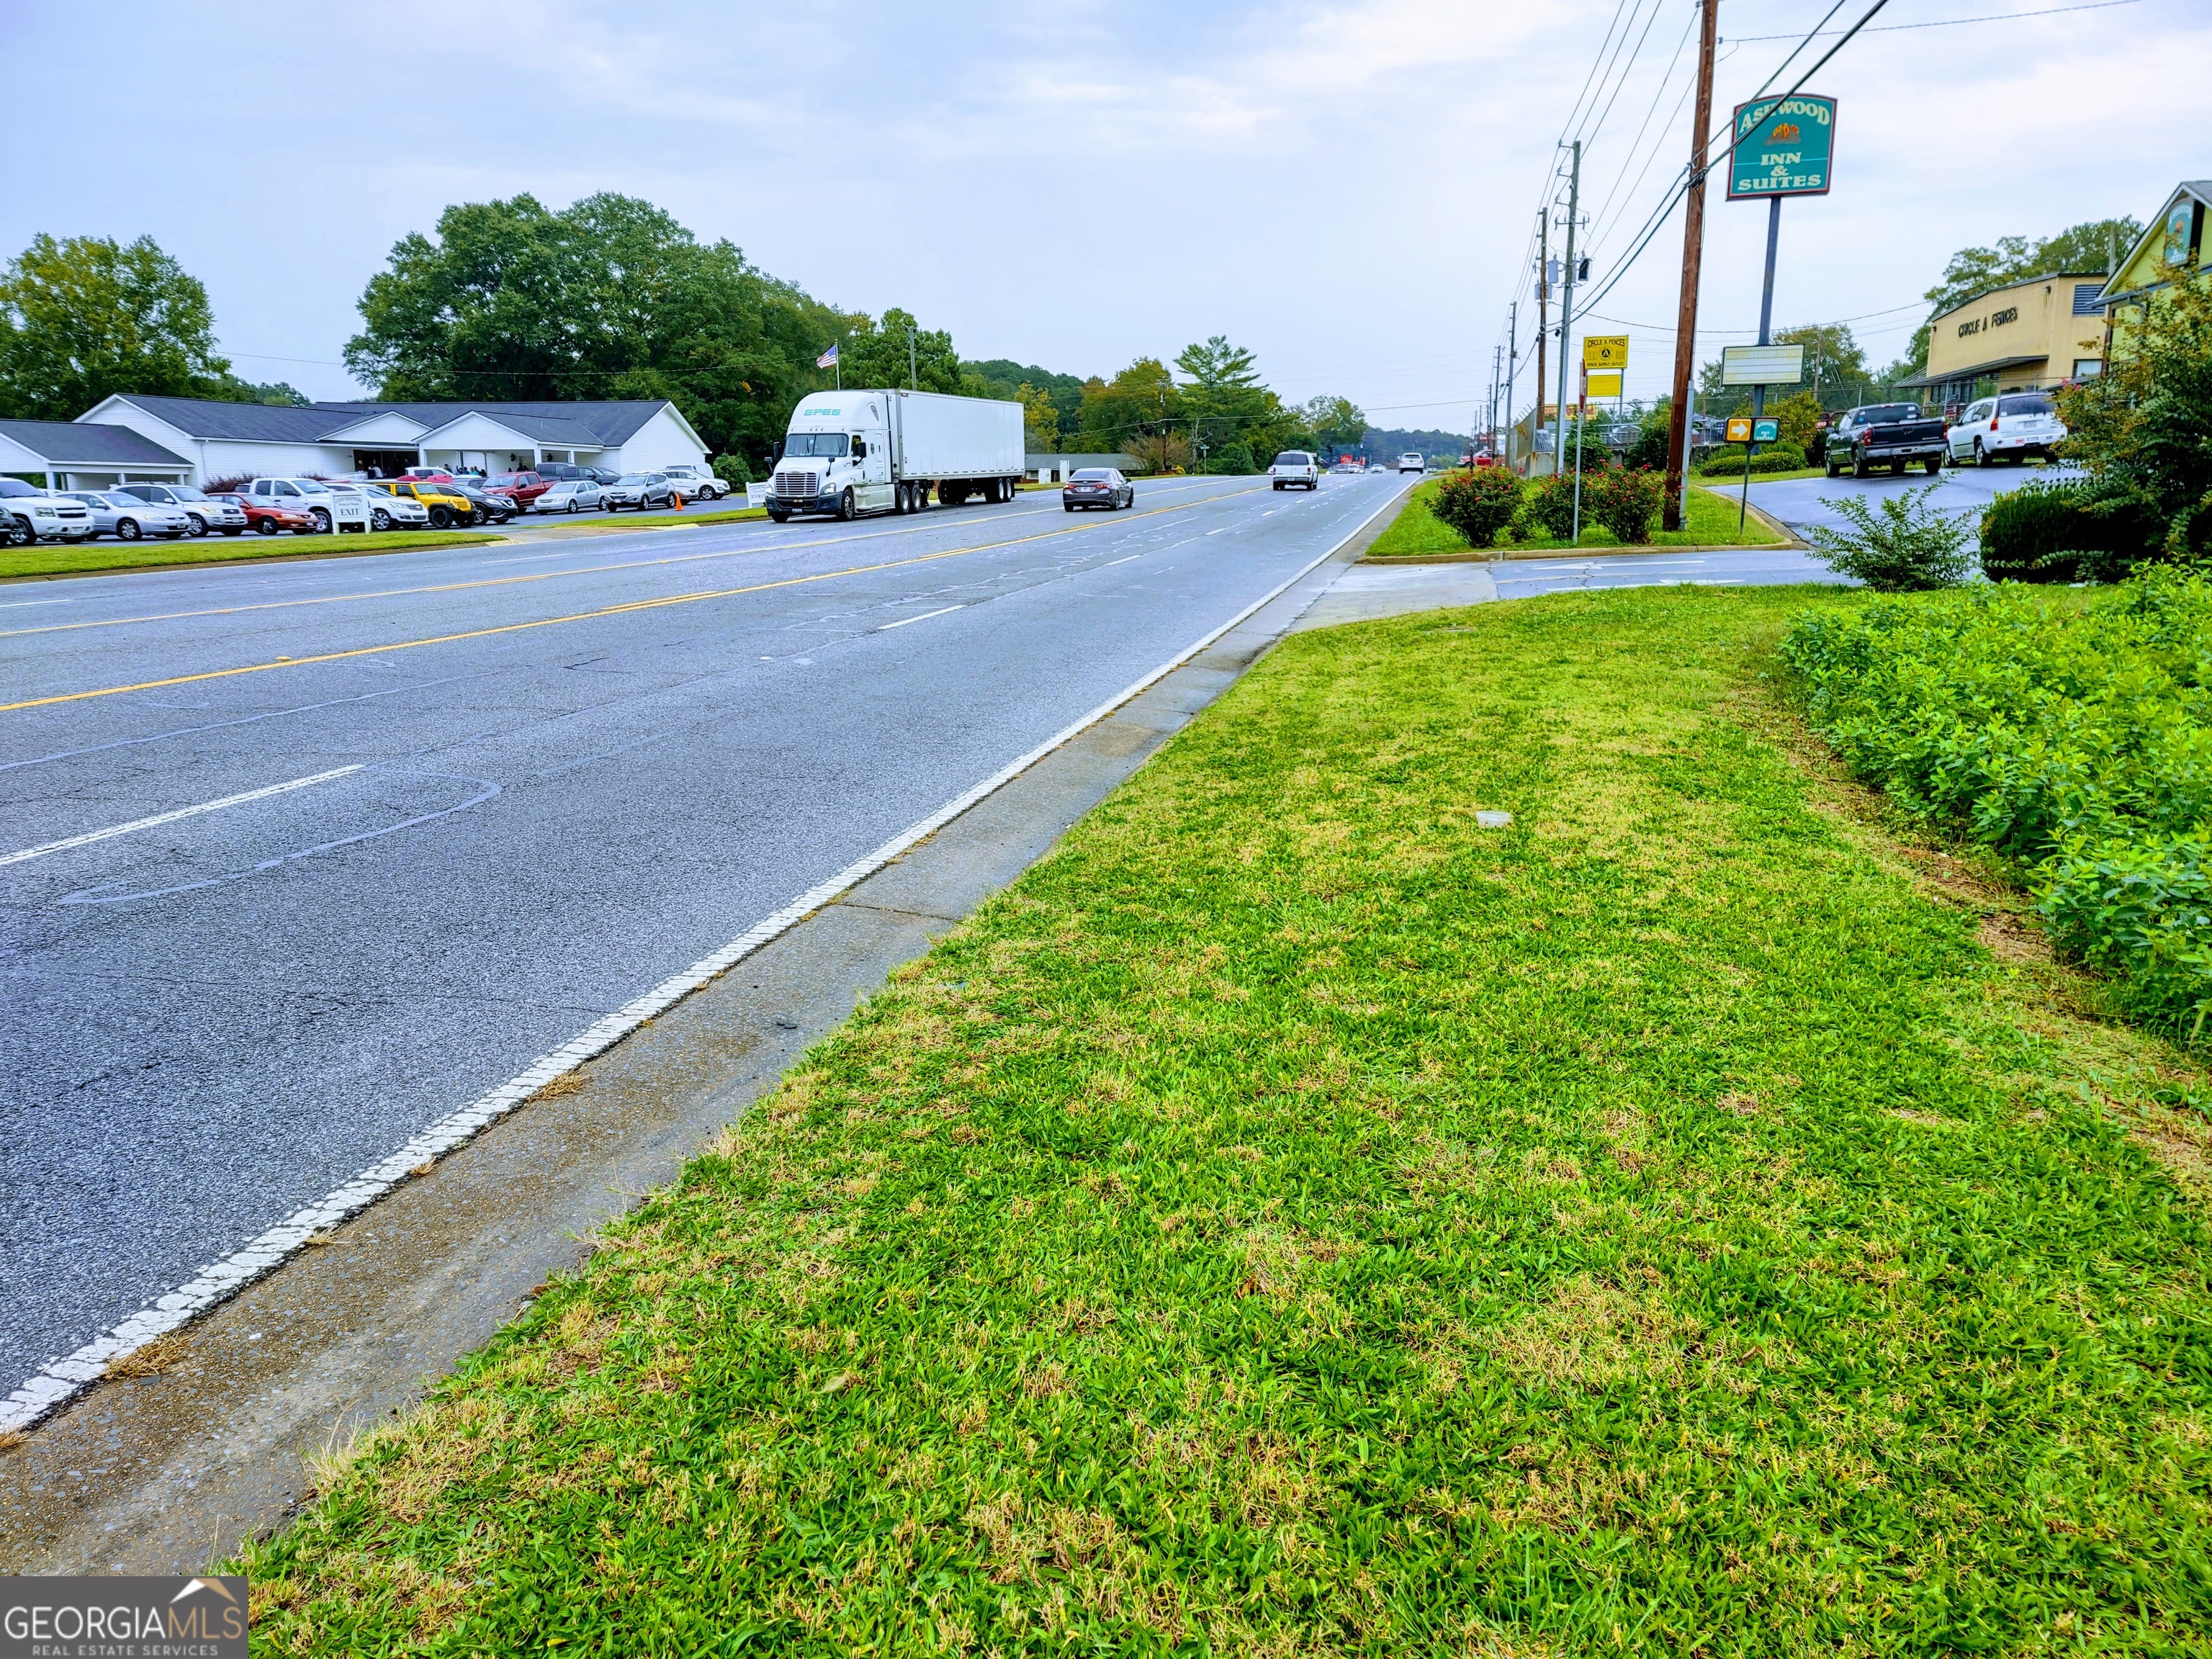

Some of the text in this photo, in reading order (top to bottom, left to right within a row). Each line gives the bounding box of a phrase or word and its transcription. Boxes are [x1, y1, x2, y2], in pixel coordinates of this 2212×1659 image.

[1739, 100, 1830, 134] ASHWOOD
[1761, 152, 1802, 166] INN
[1770, 165, 1789, 176] &
[1737, 174, 1822, 191] SUITES
[1958, 307, 2018, 338] CIRCLE A FENCES
[1588, 339, 1603, 348] CIRCLE
[1609, 338, 1625, 347] FENCES
[340, 508, 360, 516] EXIT
